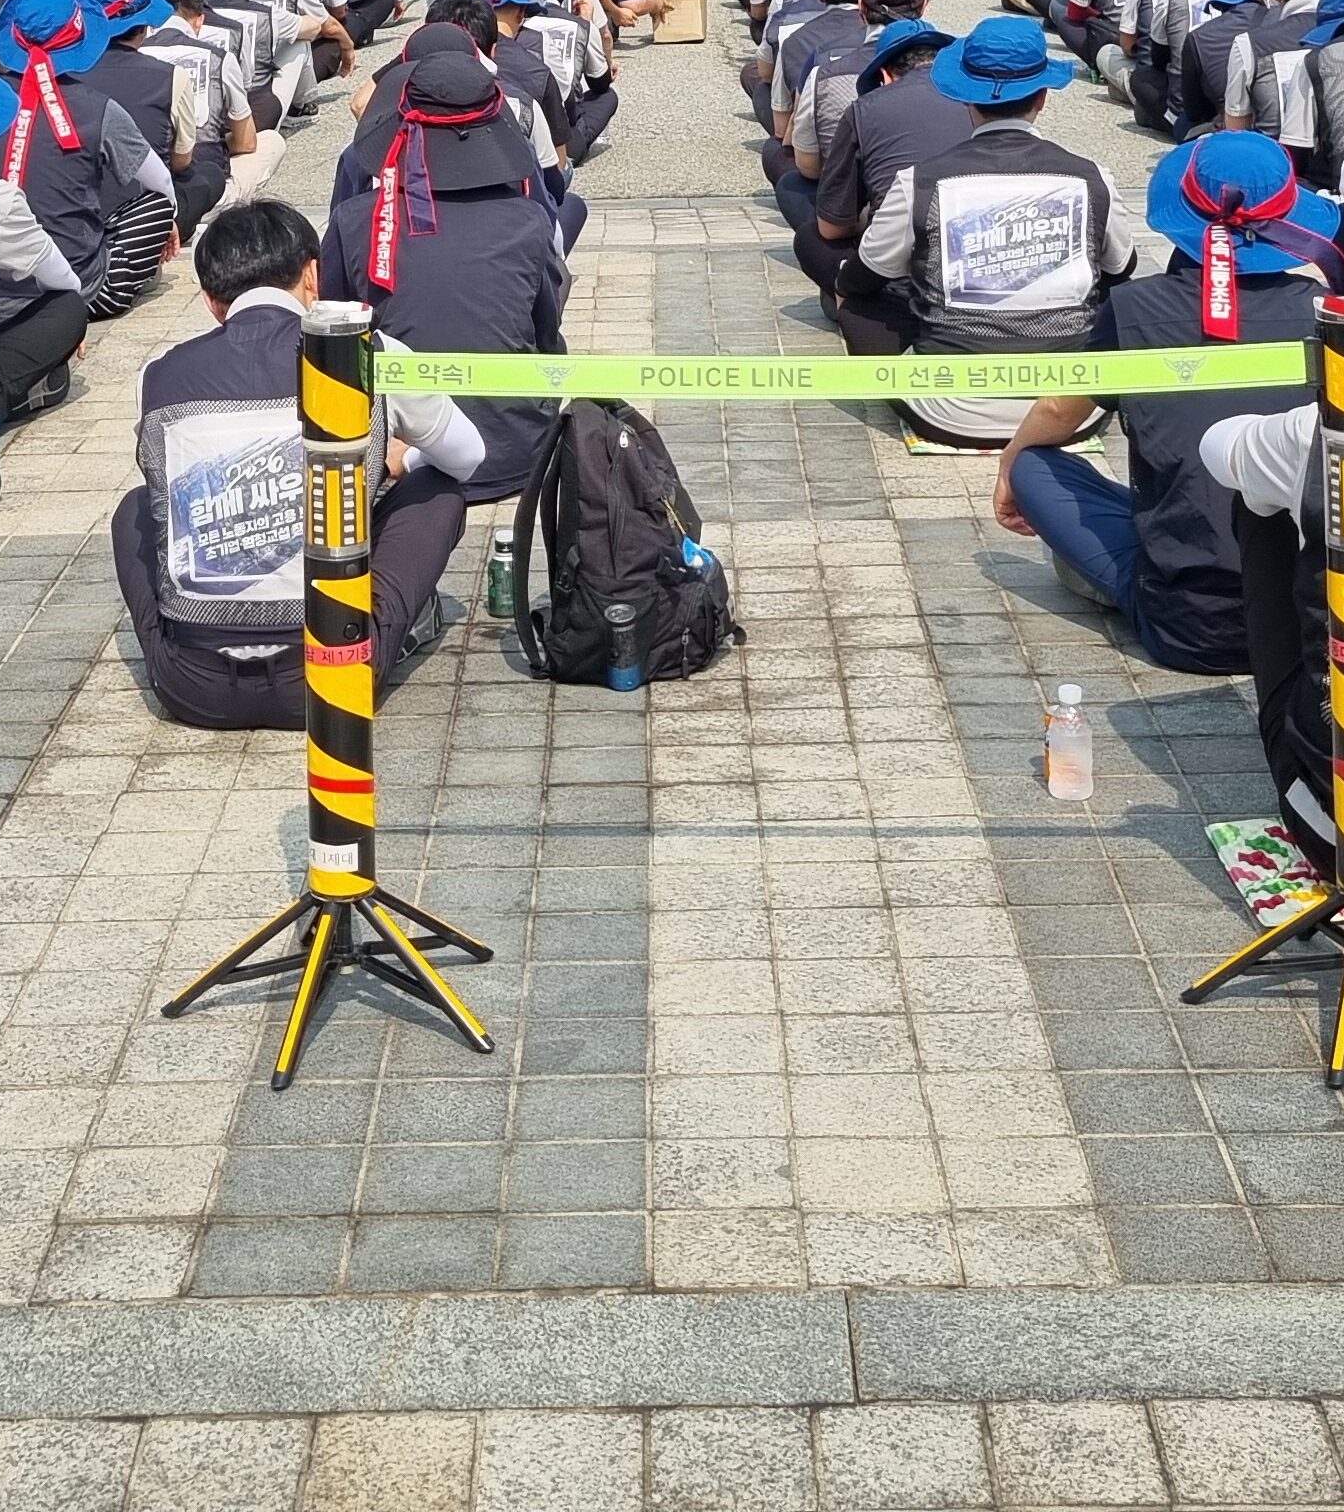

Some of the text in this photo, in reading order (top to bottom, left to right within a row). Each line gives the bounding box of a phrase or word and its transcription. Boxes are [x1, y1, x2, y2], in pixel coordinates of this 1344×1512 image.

[993, 202, 1040, 230] 2026
[962, 215, 1071, 255] 함께 싸우자
[967, 256, 987, 269] 모든
[987, 247, 1025, 264] 노동자의
[417, 363, 472, 385] 약속!
[639, 366, 814, 388] POLICE LINE
[875, 363, 1101, 389] 이 선을 넘지마시오!
[225, 448, 285, 490] 2026
[190, 472, 303, 528] 함께 싸우
[198, 508, 297, 548] 모든 노동자의 고용
